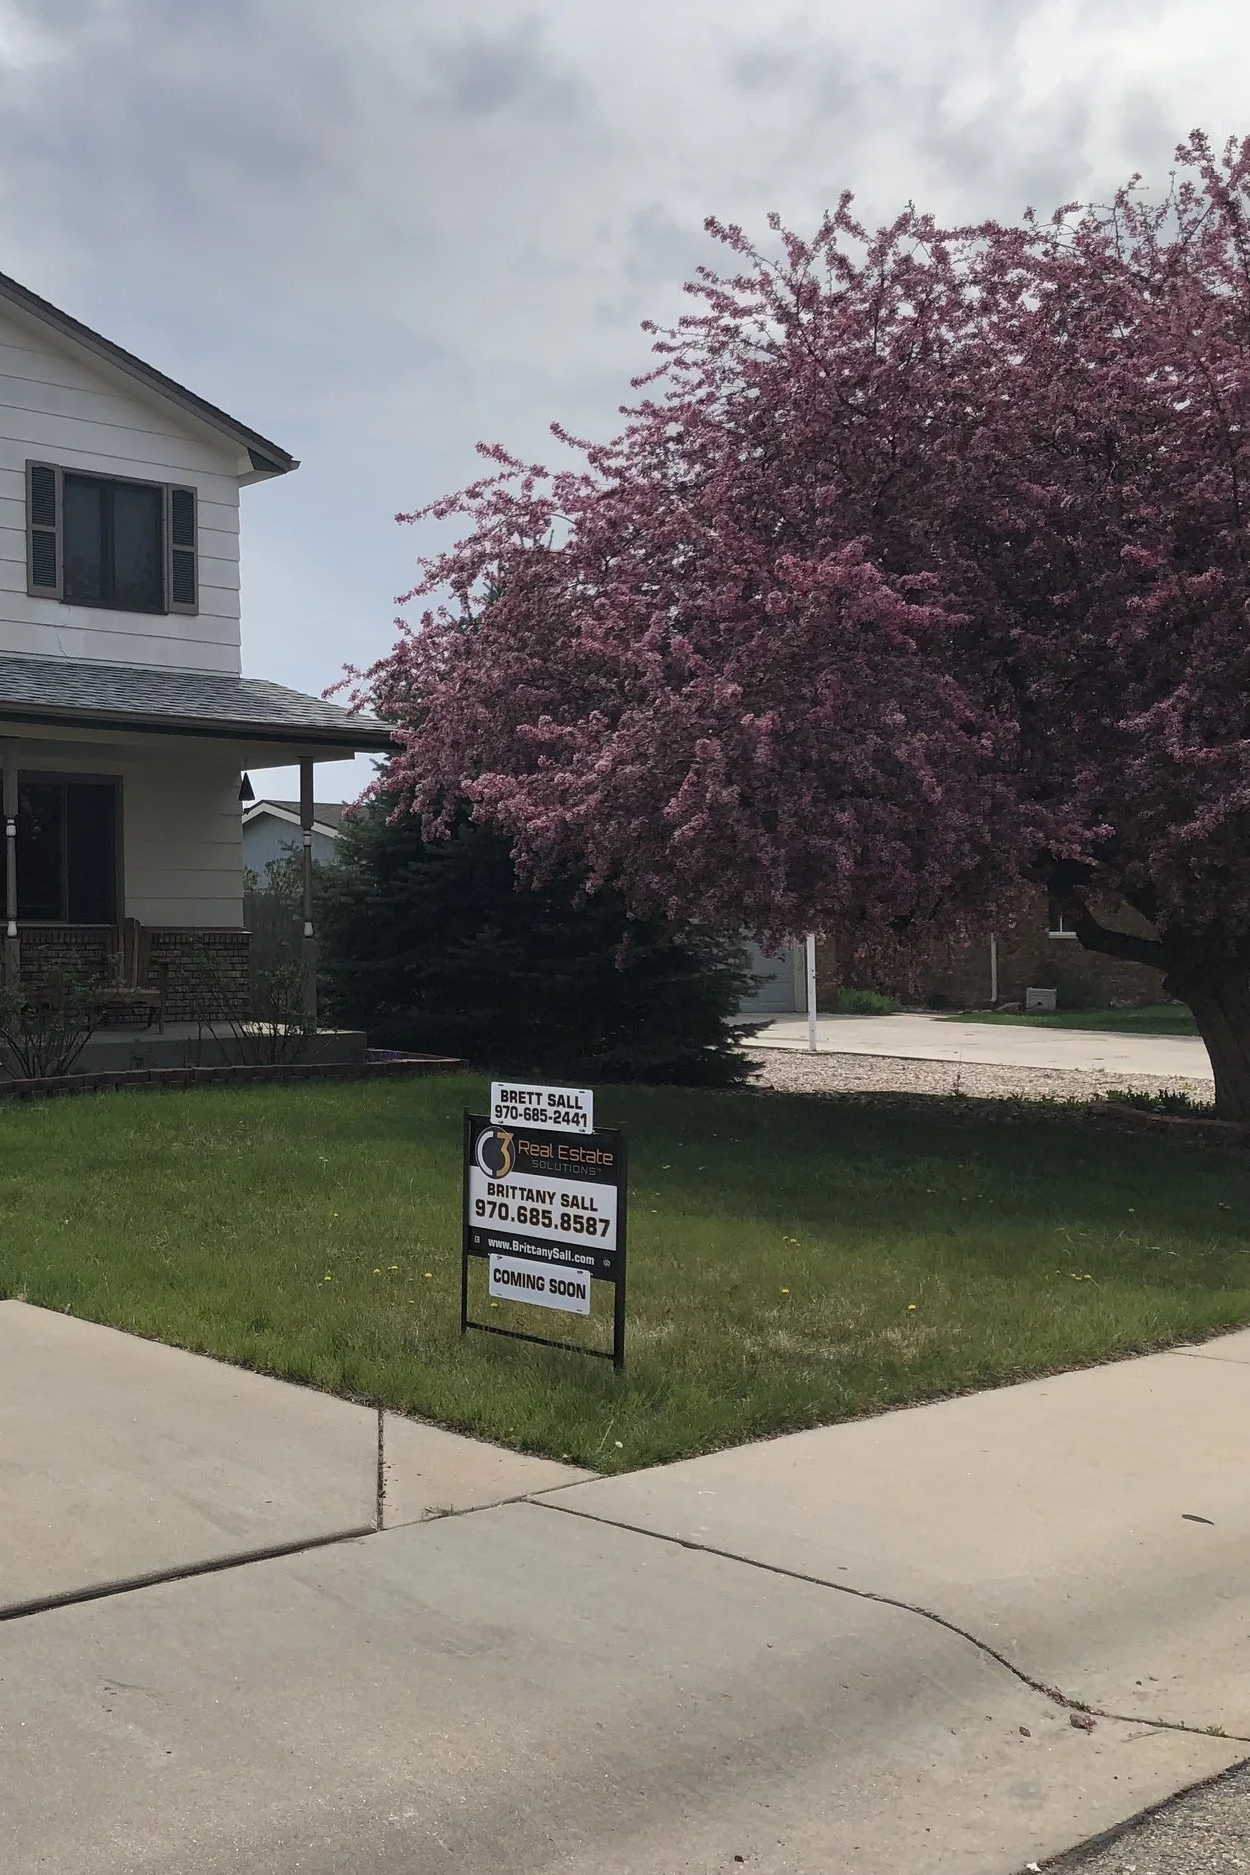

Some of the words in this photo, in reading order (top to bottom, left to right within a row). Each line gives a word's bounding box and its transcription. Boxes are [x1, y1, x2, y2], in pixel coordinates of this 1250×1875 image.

[500, 1089, 543, 1106] BRETT
[547, 1093, 583, 1110] SALL
[494, 1105, 587, 1128] 970-685-2441
[518, 1140, 554, 1158] Real
[558, 1145, 614, 1166] Estate
[487, 1182, 556, 1205] BRITTANY
[560, 1193, 599, 1212] SALL
[475, 1198, 611, 1238] 970.685.8587
[487, 1237, 595, 1266] www.BrittanySall.com
[493, 1268, 545, 1292] COMING
[549, 1278, 587, 1300] SOON
